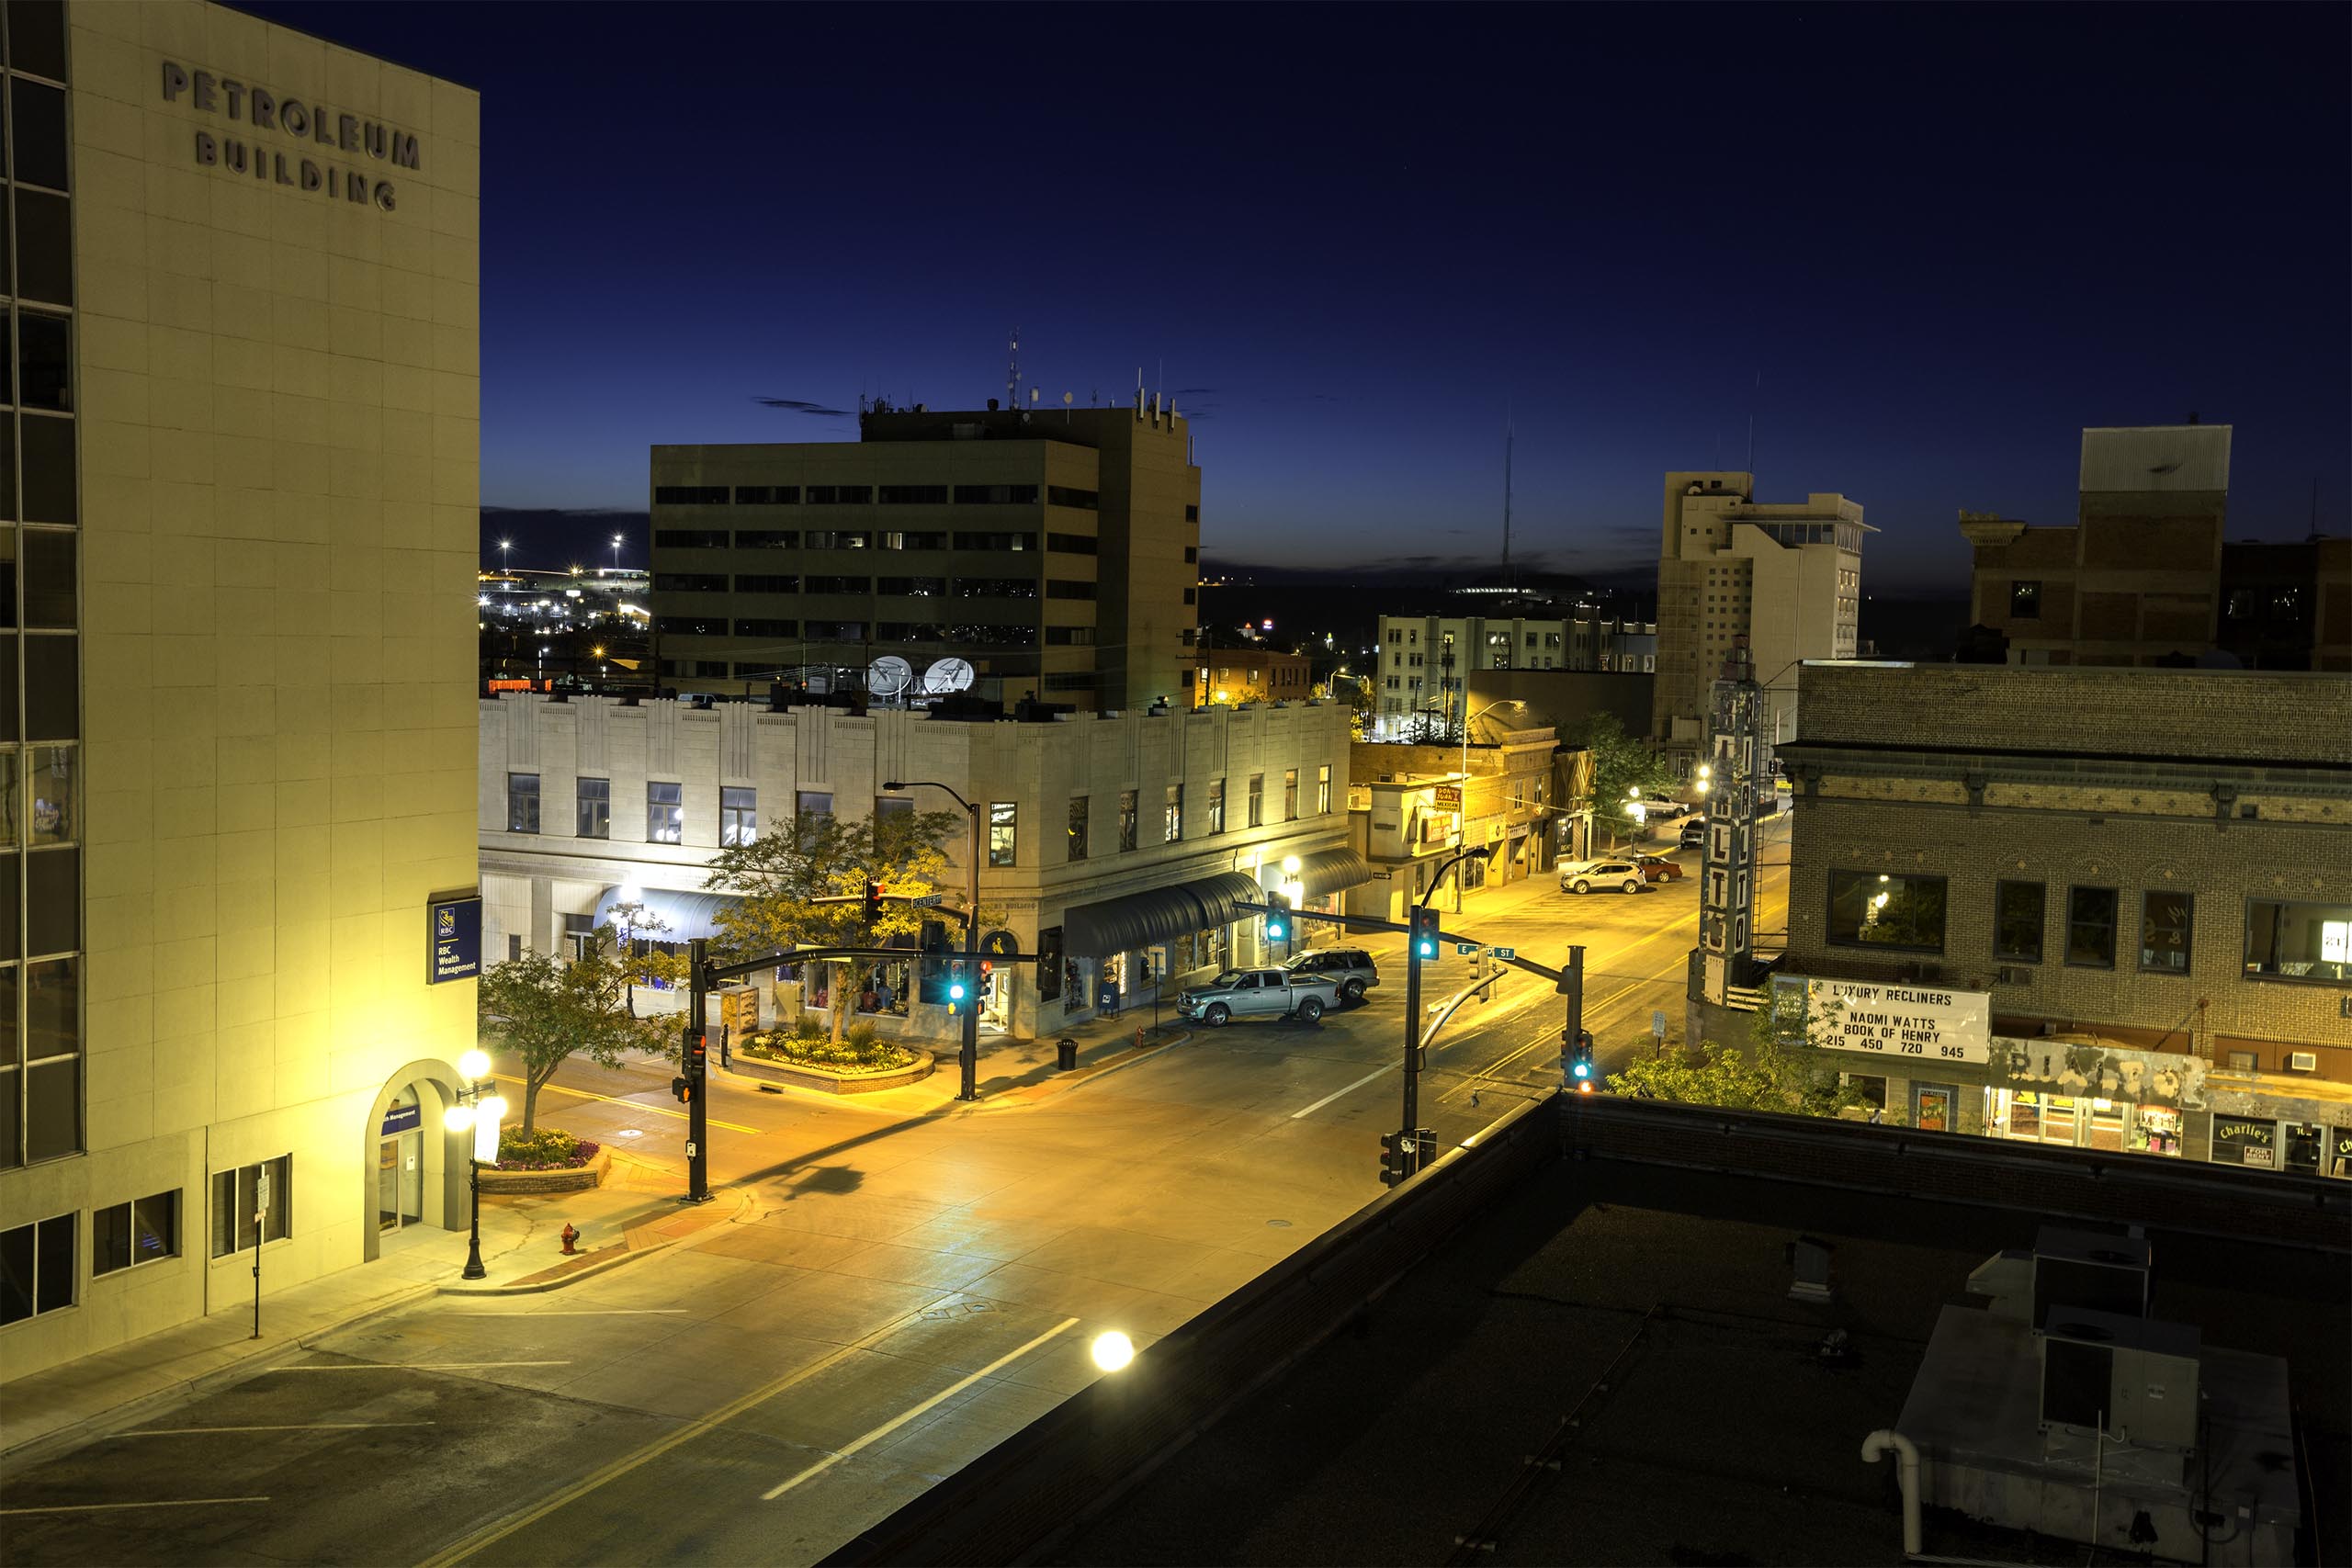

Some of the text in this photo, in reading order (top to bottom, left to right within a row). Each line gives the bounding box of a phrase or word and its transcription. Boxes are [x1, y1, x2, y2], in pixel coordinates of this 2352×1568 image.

[163, 60, 420, 171] PETROLEUM
[196, 130, 396, 212] BUILDING
[916, 897, 937, 908] CENTER
[438, 946, 451, 955] RBC
[438, 954, 459, 965] Wealth
[1500, 949, 1510, 957] ST
[438, 962, 476, 976] Management
[1833, 985, 1951, 1006] LUXURY RECLINERS
[1849, 1012, 1936, 1030] NAOMI WATTS
[1844, 1024, 1940, 1043] BOOK OF HENRY
[1826, 1035, 1964, 1058] 215 450 720 945
[390, 1110, 415, 1121] Management
[2220, 1123, 2269, 1144] Charlie's
